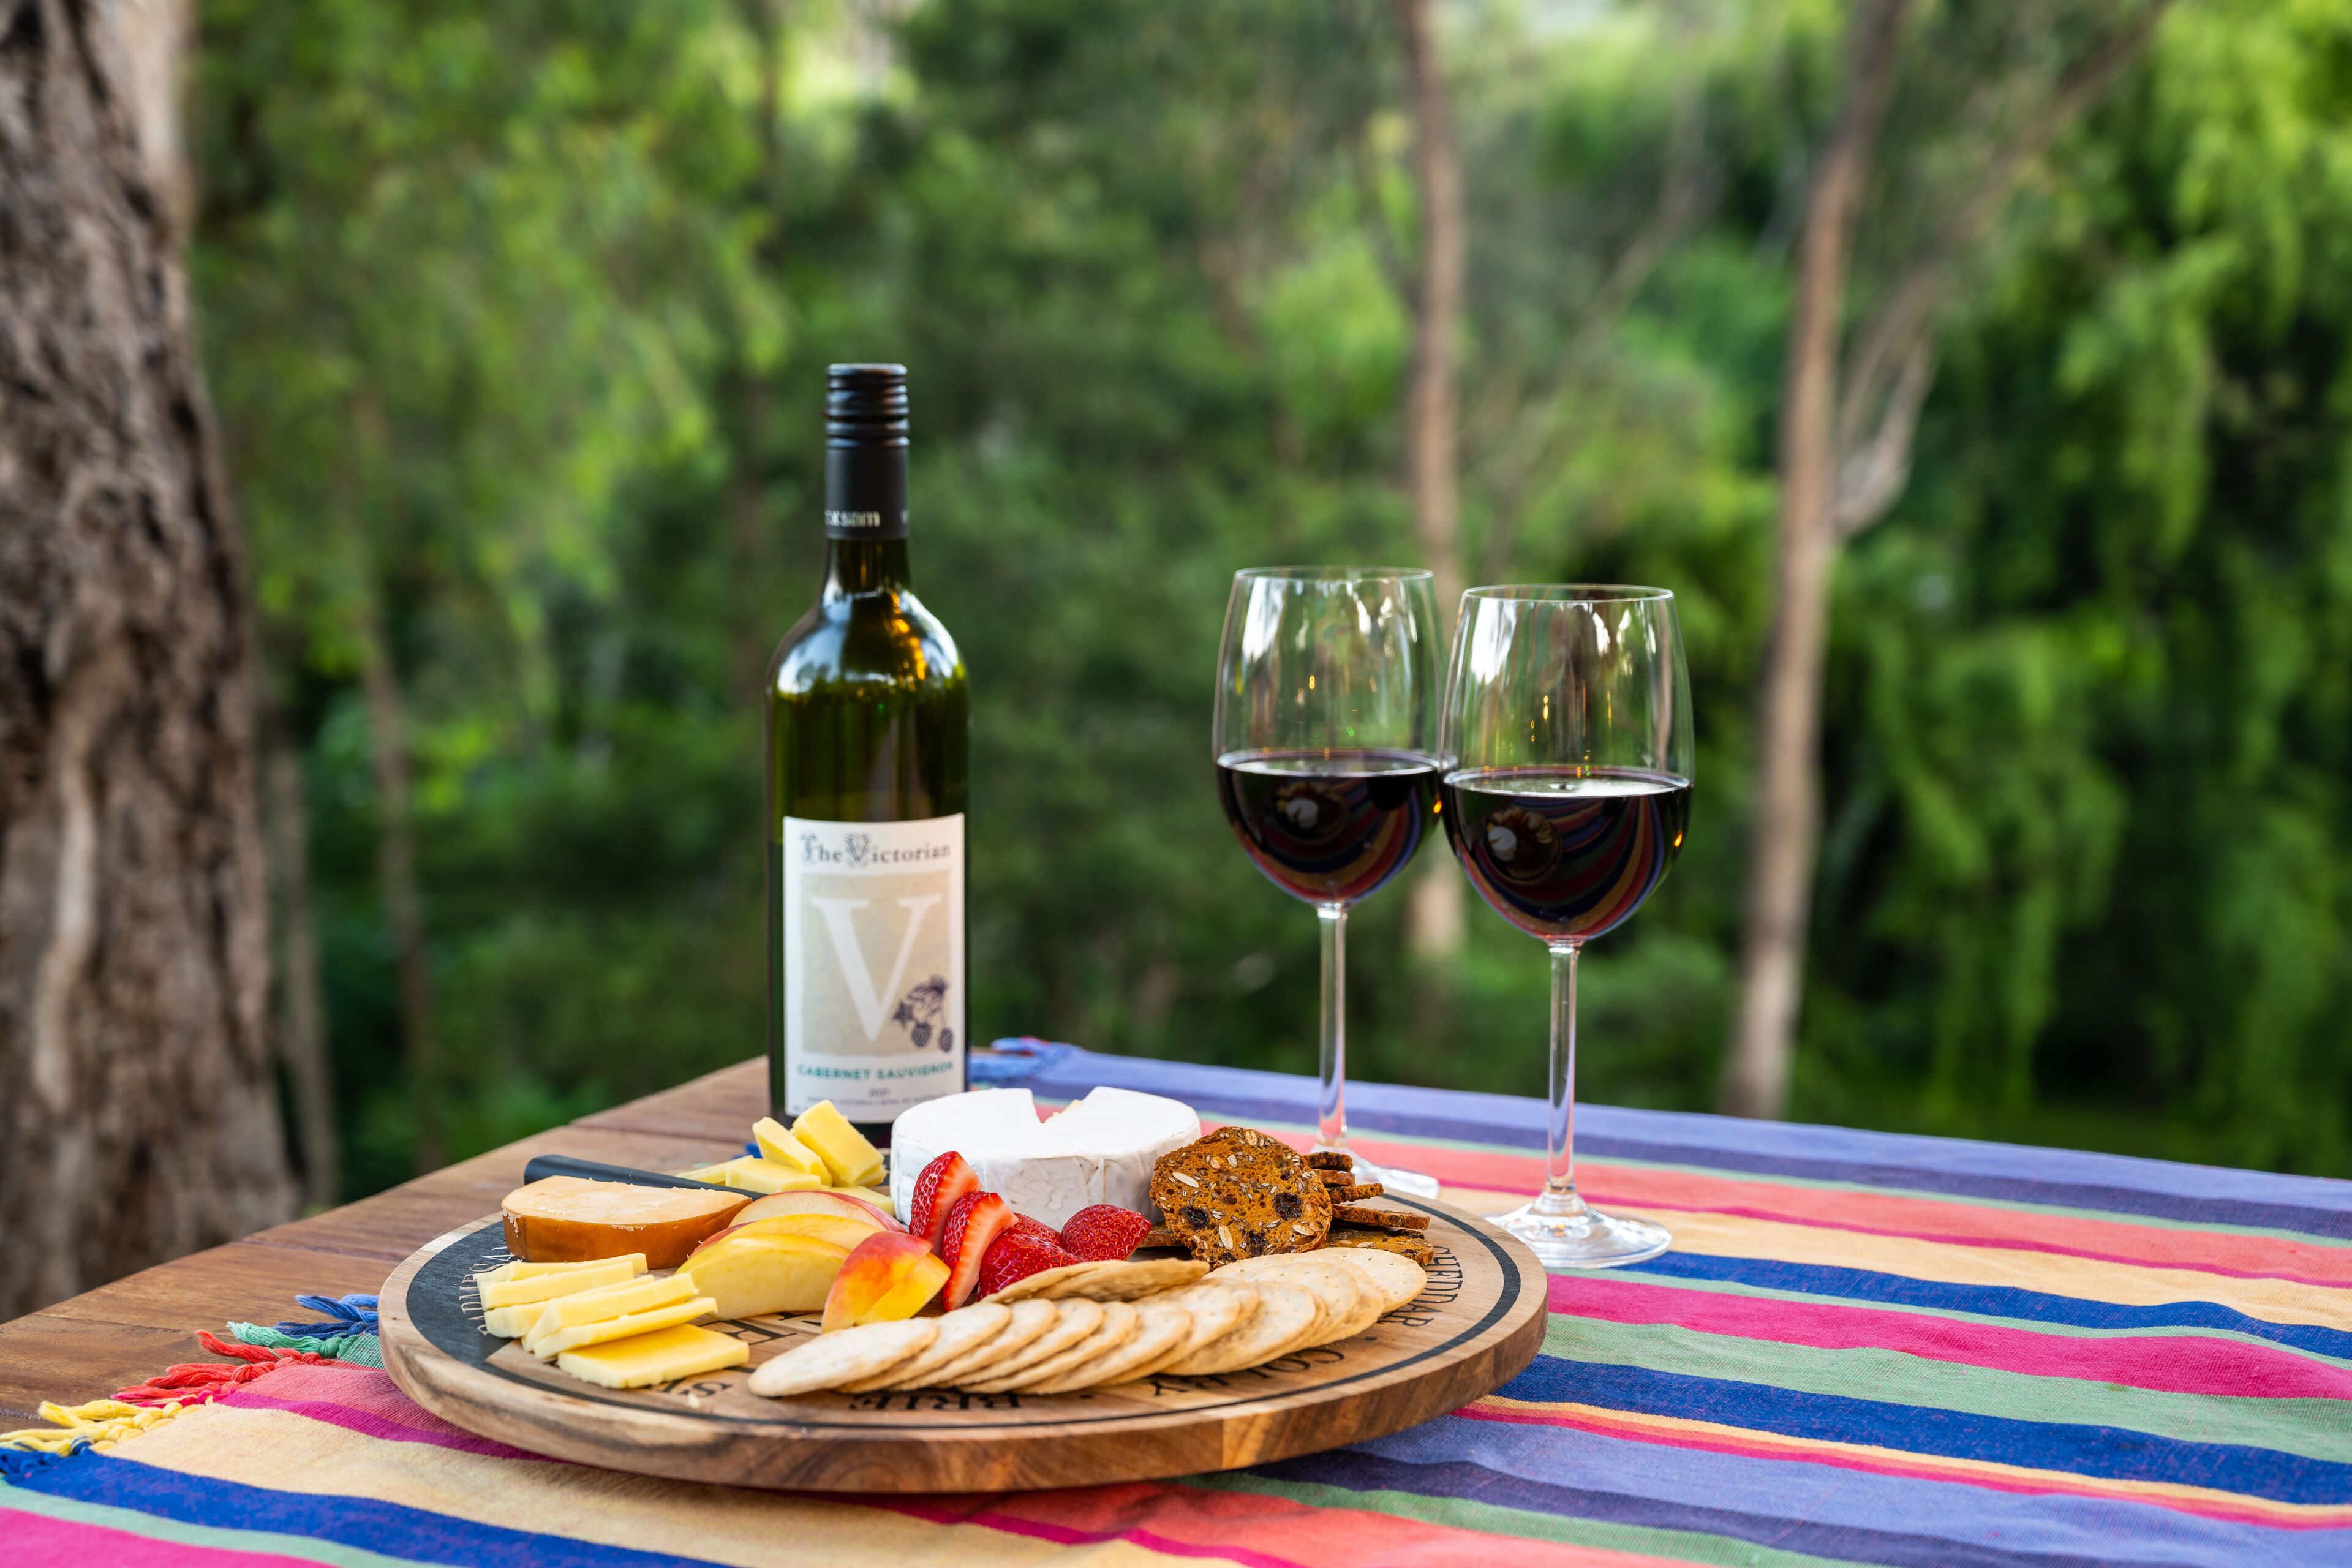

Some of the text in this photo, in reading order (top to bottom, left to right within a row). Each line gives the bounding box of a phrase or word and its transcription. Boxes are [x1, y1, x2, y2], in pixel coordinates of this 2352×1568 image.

[800, 832, 951, 867] The Victorian
[810, 892, 942, 1041] V
[796, 1061, 954, 1080] CABERNET SAUVIGNON
[459, 1246, 516, 1336] RMESA
[1377, 1245, 1463, 1327] CHEDDAR
